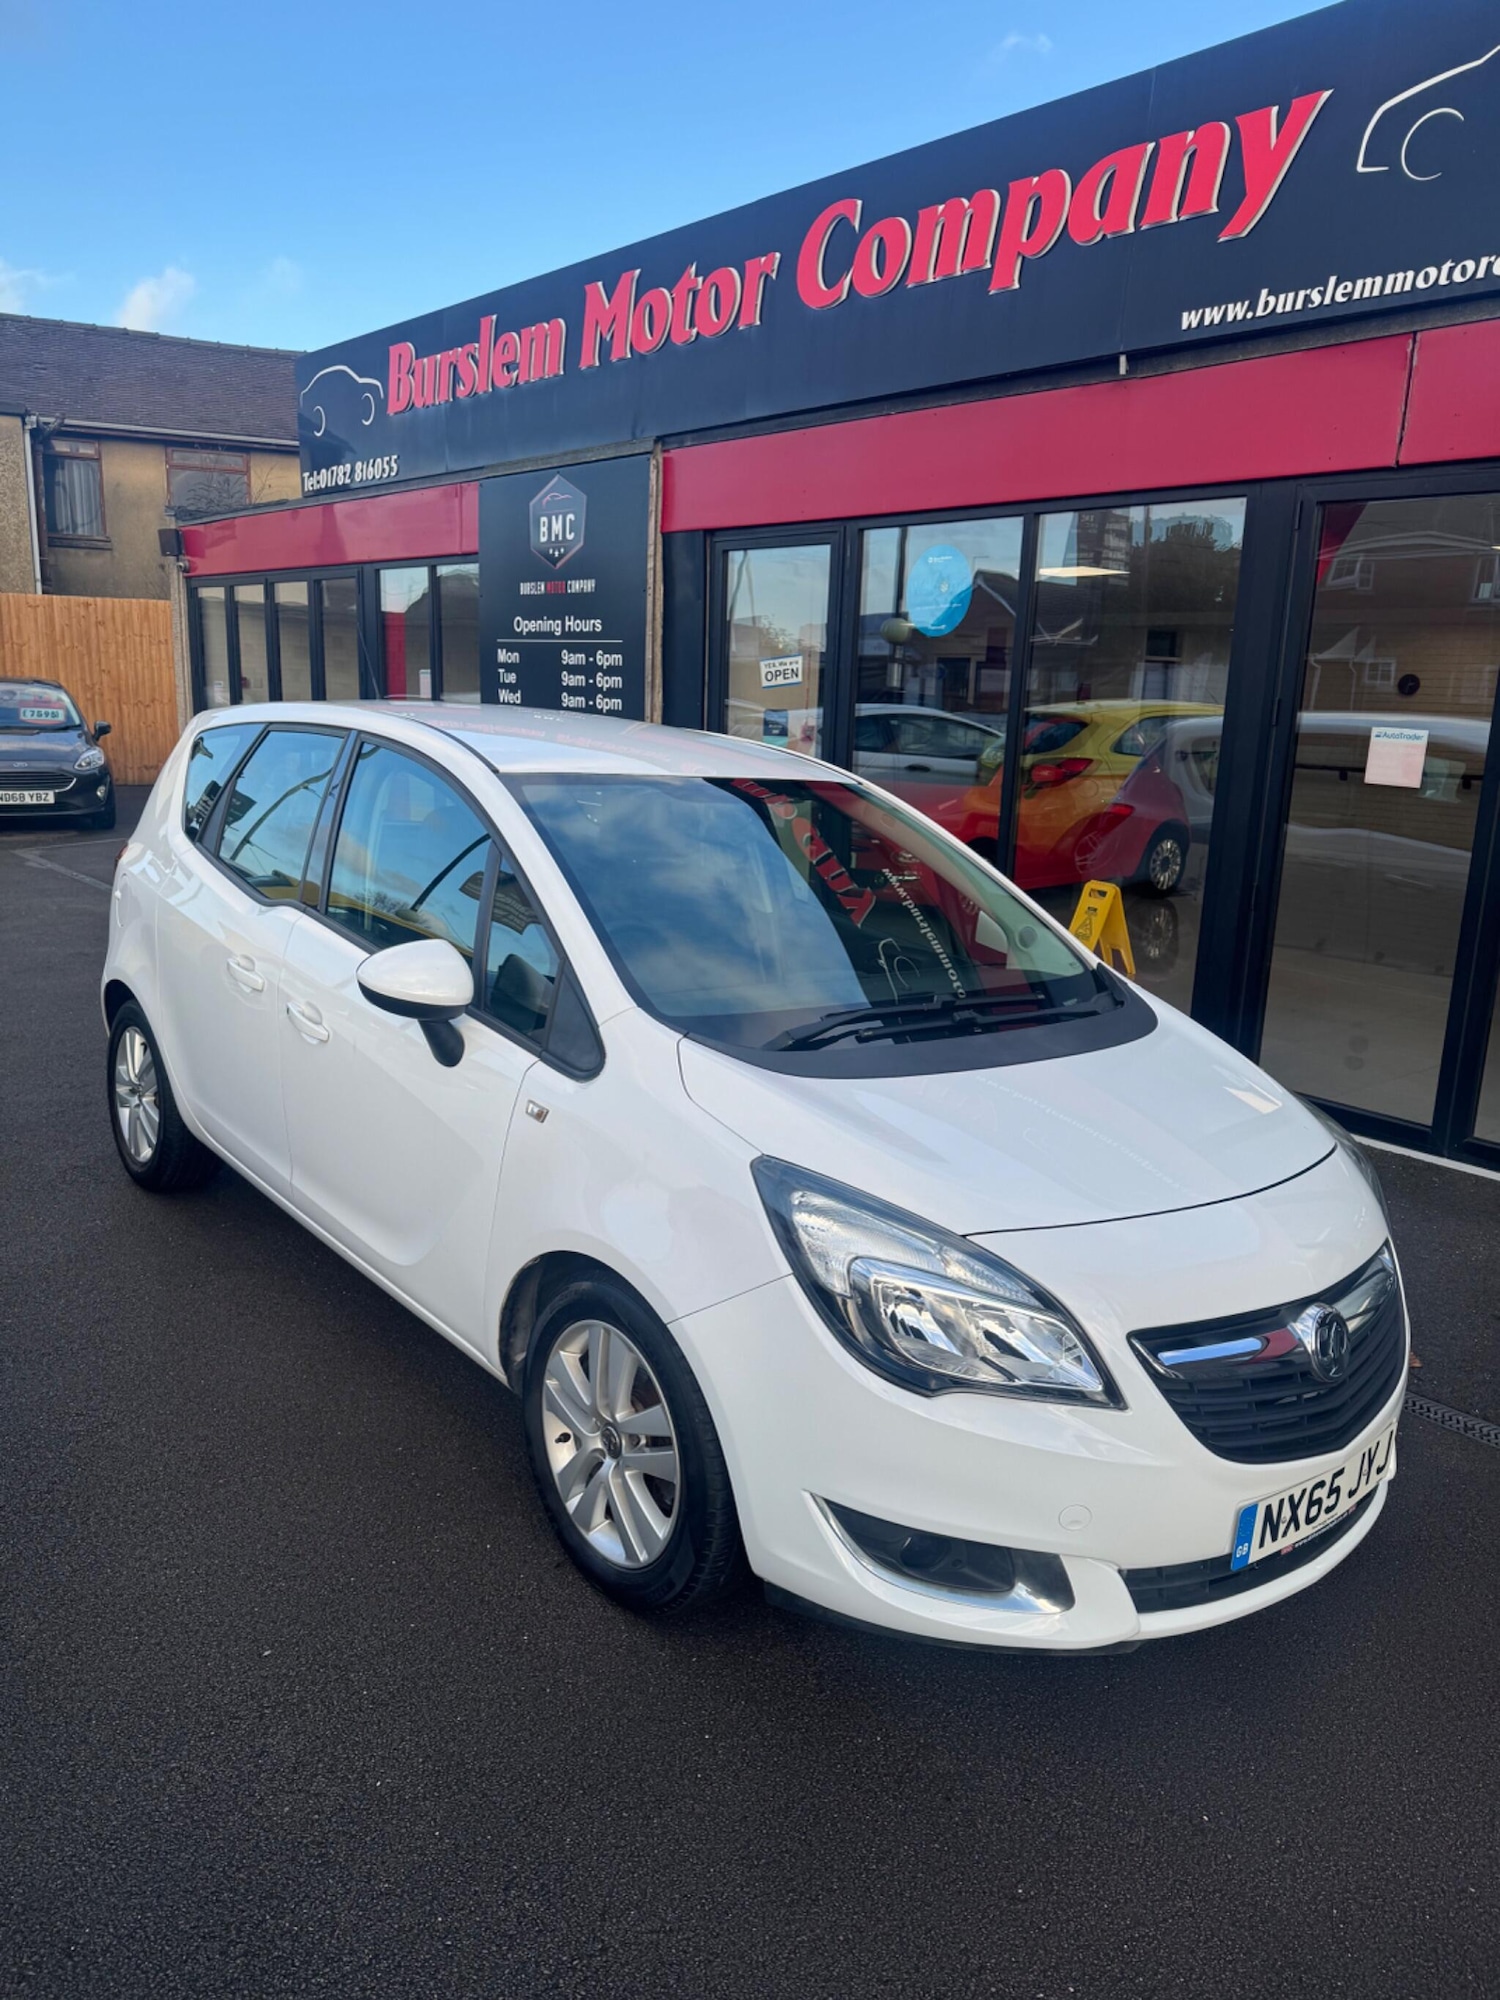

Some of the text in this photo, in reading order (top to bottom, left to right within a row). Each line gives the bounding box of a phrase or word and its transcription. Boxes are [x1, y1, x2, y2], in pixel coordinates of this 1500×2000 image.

[386, 88, 1334, 416] Burslem Motor Company
[302, 454, 399, 492] Tel:01782 816055
[539, 513, 576, 543] BMC
[519, 581, 545, 595] BURSLEM
[567, 579, 596, 593] COMPANY
[513, 615, 602, 636] Opening Hours
[497, 648, 520, 664] Mon
[560, 649, 586, 665] 9am
[595, 649, 623, 669] 6pm
[497, 668, 517, 684] Tue
[560, 671, 586, 687] 9am
[595, 672, 623, 691] 6pm
[764, 667, 799, 682] OPEN
[497, 689, 521, 704] Wed
[560, 692, 586, 708] 9am
[595, 693, 623, 713] 6pm
[27, 792, 49, 802] YBZ
[1258, 1466, 1346, 1549] NX65
[1347, 1429, 1394, 1499] JYJ
[1236, 1542, 1249, 1558] GB
